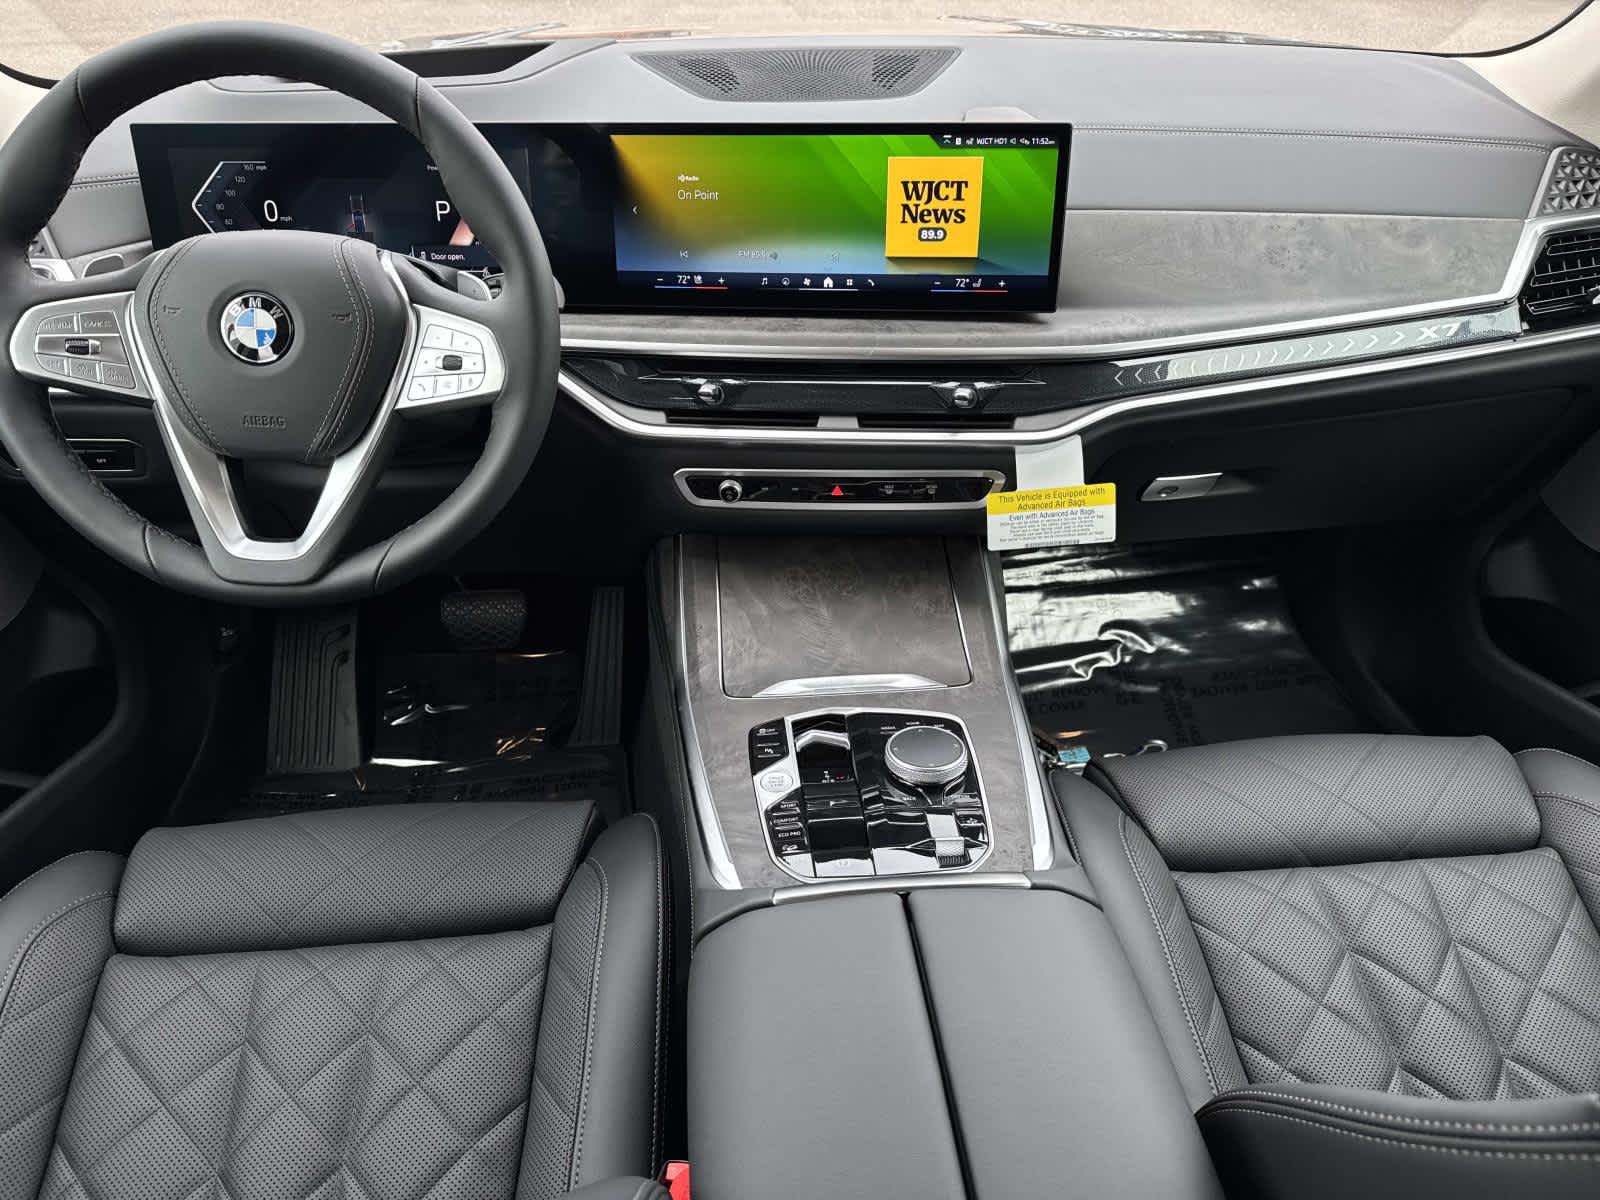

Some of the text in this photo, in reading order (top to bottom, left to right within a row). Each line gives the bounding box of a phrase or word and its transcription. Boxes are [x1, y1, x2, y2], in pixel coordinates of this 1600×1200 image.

[677, 189, 720, 200] On Point
[900, 180, 969, 205] WJCT
[263, 199, 279, 222] 0
[435, 200, 451, 222] P
[900, 203, 967, 224] News
[920, 229, 945, 240] 89.9
[430, 252, 447, 260] Door
[228, 296, 284, 319] BMW
[1415, 322, 1461, 342] X7
[242, 415, 287, 428] AIRBAG
[999, 487, 1106, 504] This Vehicle is Equipped with
[1017, 498, 1086, 511] Advanced Air Bags
[1040, 510, 1068, 519] Advanced
